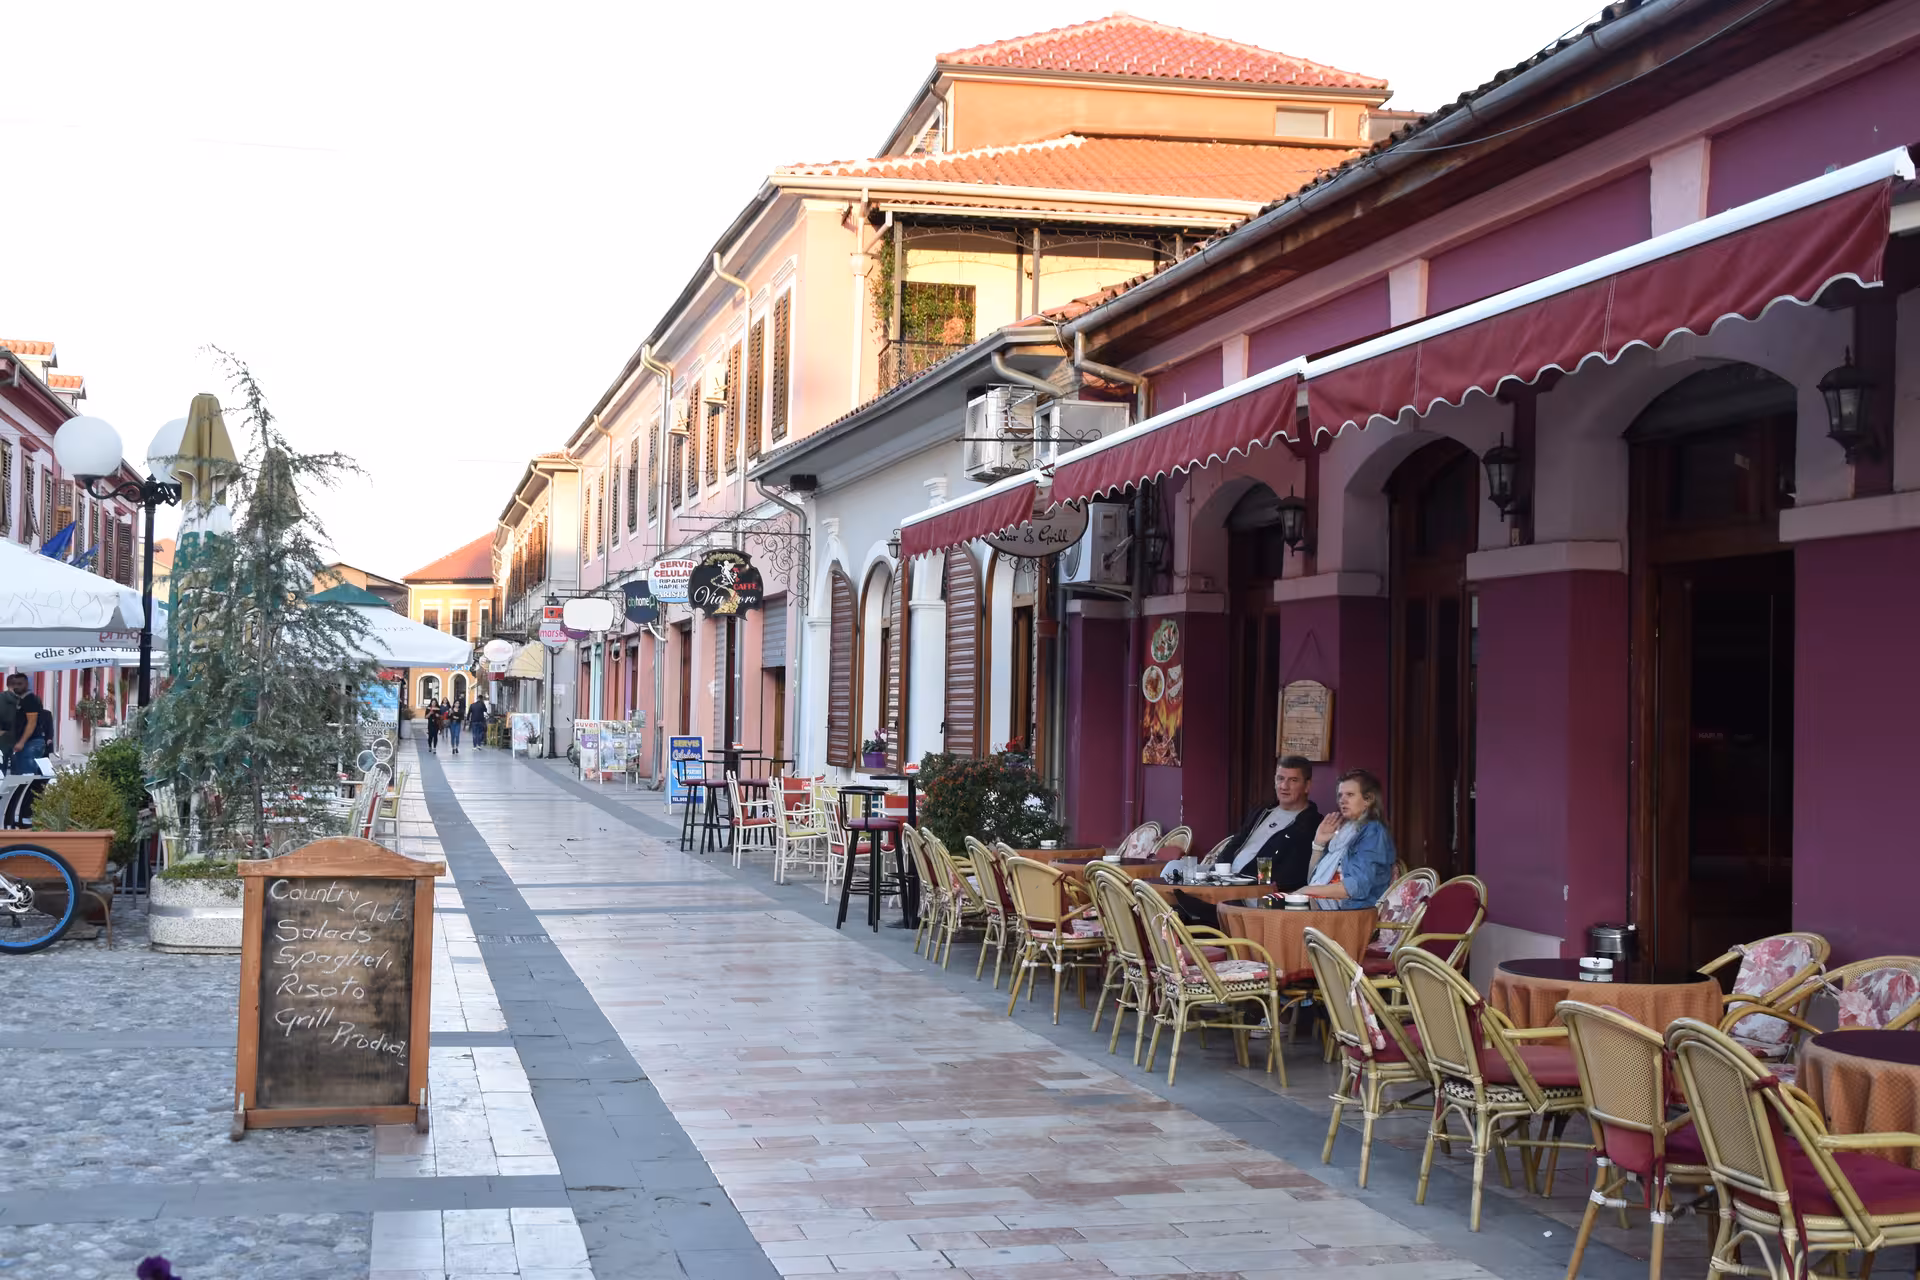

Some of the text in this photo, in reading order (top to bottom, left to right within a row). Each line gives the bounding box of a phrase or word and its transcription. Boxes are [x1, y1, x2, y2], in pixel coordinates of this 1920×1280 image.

[1023, 526, 1035, 544] &
[1038, 524, 1069, 545] Grill
[659, 560, 694, 569] SERVIS
[693, 585, 724, 606] Via
[733, 582, 757, 590] CAFFE
[34, 647, 65, 659] edhe
[270, 879, 360, 911] Country
[353, 900, 407, 925] Club
[275, 919, 372, 943] Salads
[275, 972, 365, 1000] Risoto
[274, 1006, 336, 1037] Grill
